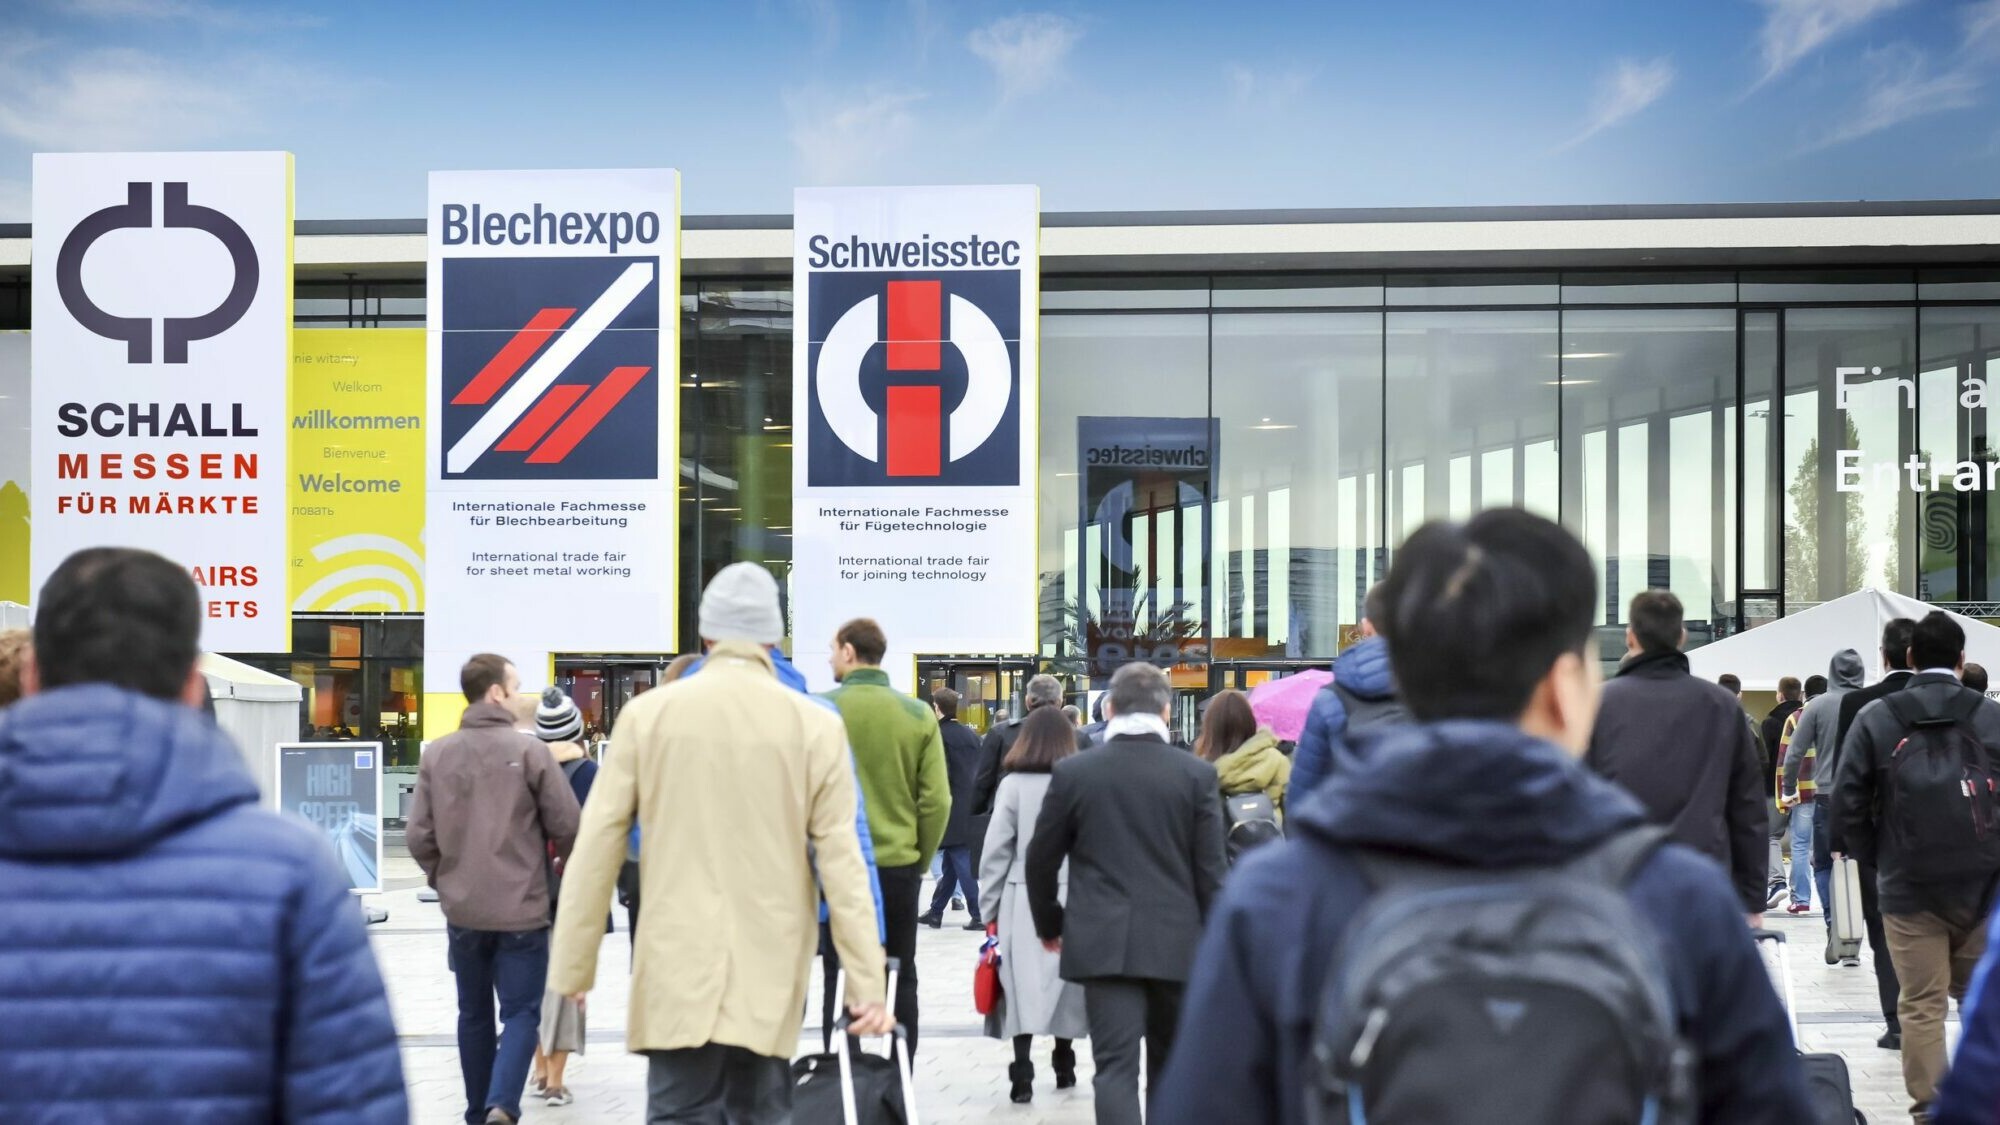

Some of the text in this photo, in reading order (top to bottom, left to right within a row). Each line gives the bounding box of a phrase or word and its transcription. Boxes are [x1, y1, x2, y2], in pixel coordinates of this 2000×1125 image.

[441, 203, 660, 254] Blechexpo
[808, 234, 1021, 269] Schweisstec
[332, 381, 383, 393] Welkom
[57, 402, 259, 438] SCHALL
[292, 409, 421, 430] willkommen
[323, 447, 387, 459] Bienvenue
[58, 453, 259, 480] MESSEN
[299, 472, 401, 493] Welcome
[58, 491, 259, 515] FÜR MÄRKTE
[452, 501, 647, 512] Internationale Fachmesse
[292, 506, 334, 516] ловать
[819, 507, 1009, 517] Internationale Fachmesse
[470, 515, 628, 528] für Blechbearbeitung
[840, 520, 987, 533] für Fügetechnologie
[472, 551, 627, 562] International trade fair
[838, 555, 990, 566] International trade fair
[192, 565, 259, 587] AIRS
[466, 566, 631, 578] for sheet metal working
[840, 570, 987, 582] for joining technology
[306, 764, 352, 796] HIGH
